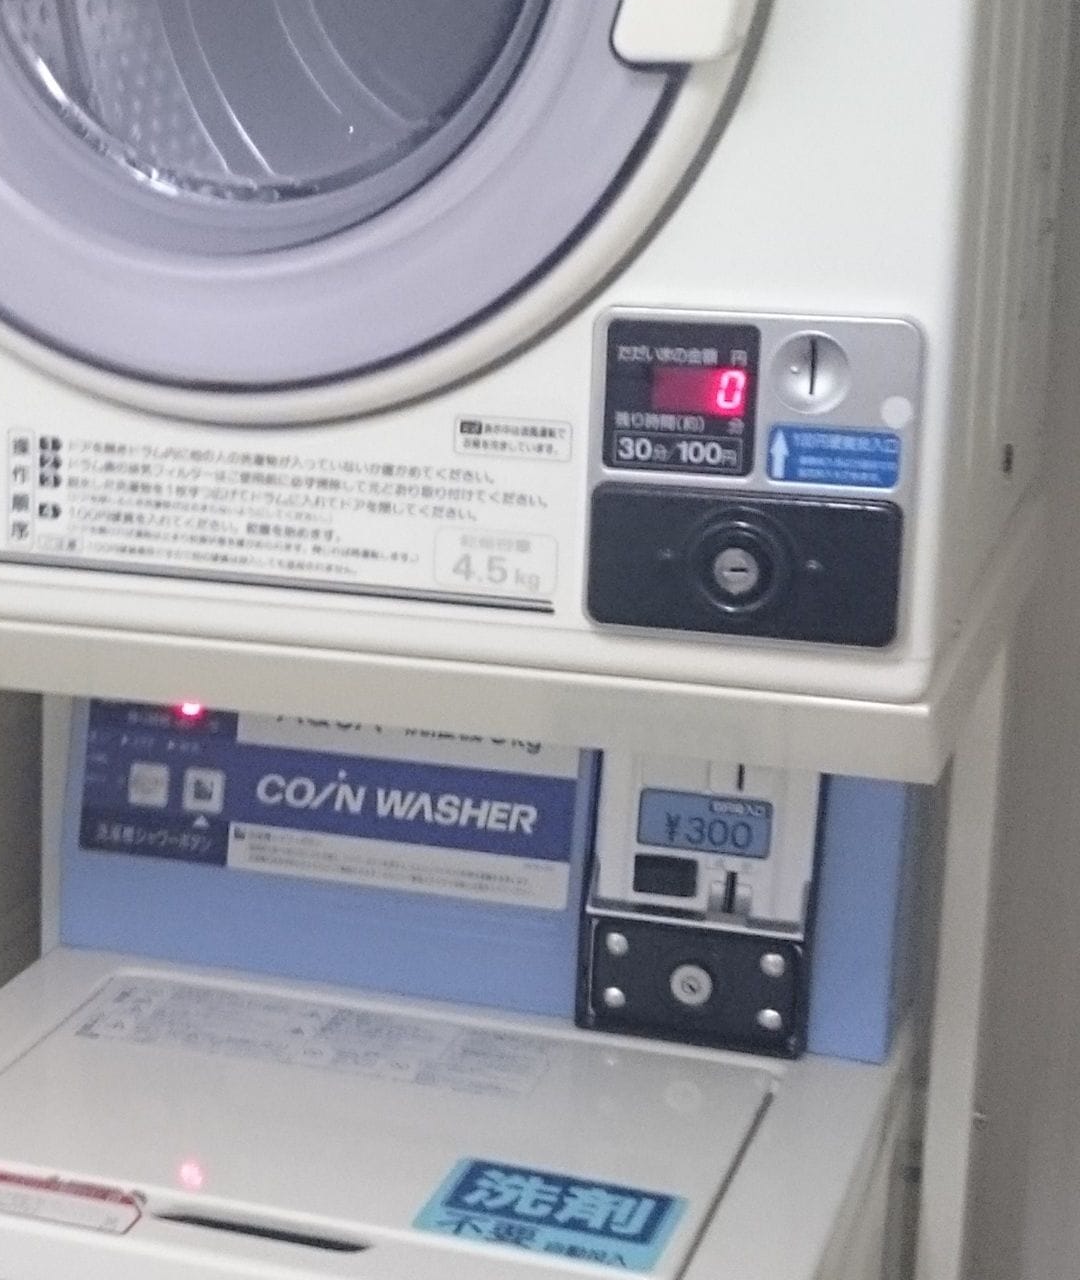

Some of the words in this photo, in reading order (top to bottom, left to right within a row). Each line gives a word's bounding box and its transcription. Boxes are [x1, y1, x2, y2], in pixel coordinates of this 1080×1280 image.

[716, 371, 746, 410] 0
[256, 769, 364, 814] COIN
[376, 788, 539, 836] WASHER
[664, 811, 754, 849] ¥300
[464, 1168, 656, 1235] 洗剤
[436, 1210, 539, 1249] 不要
